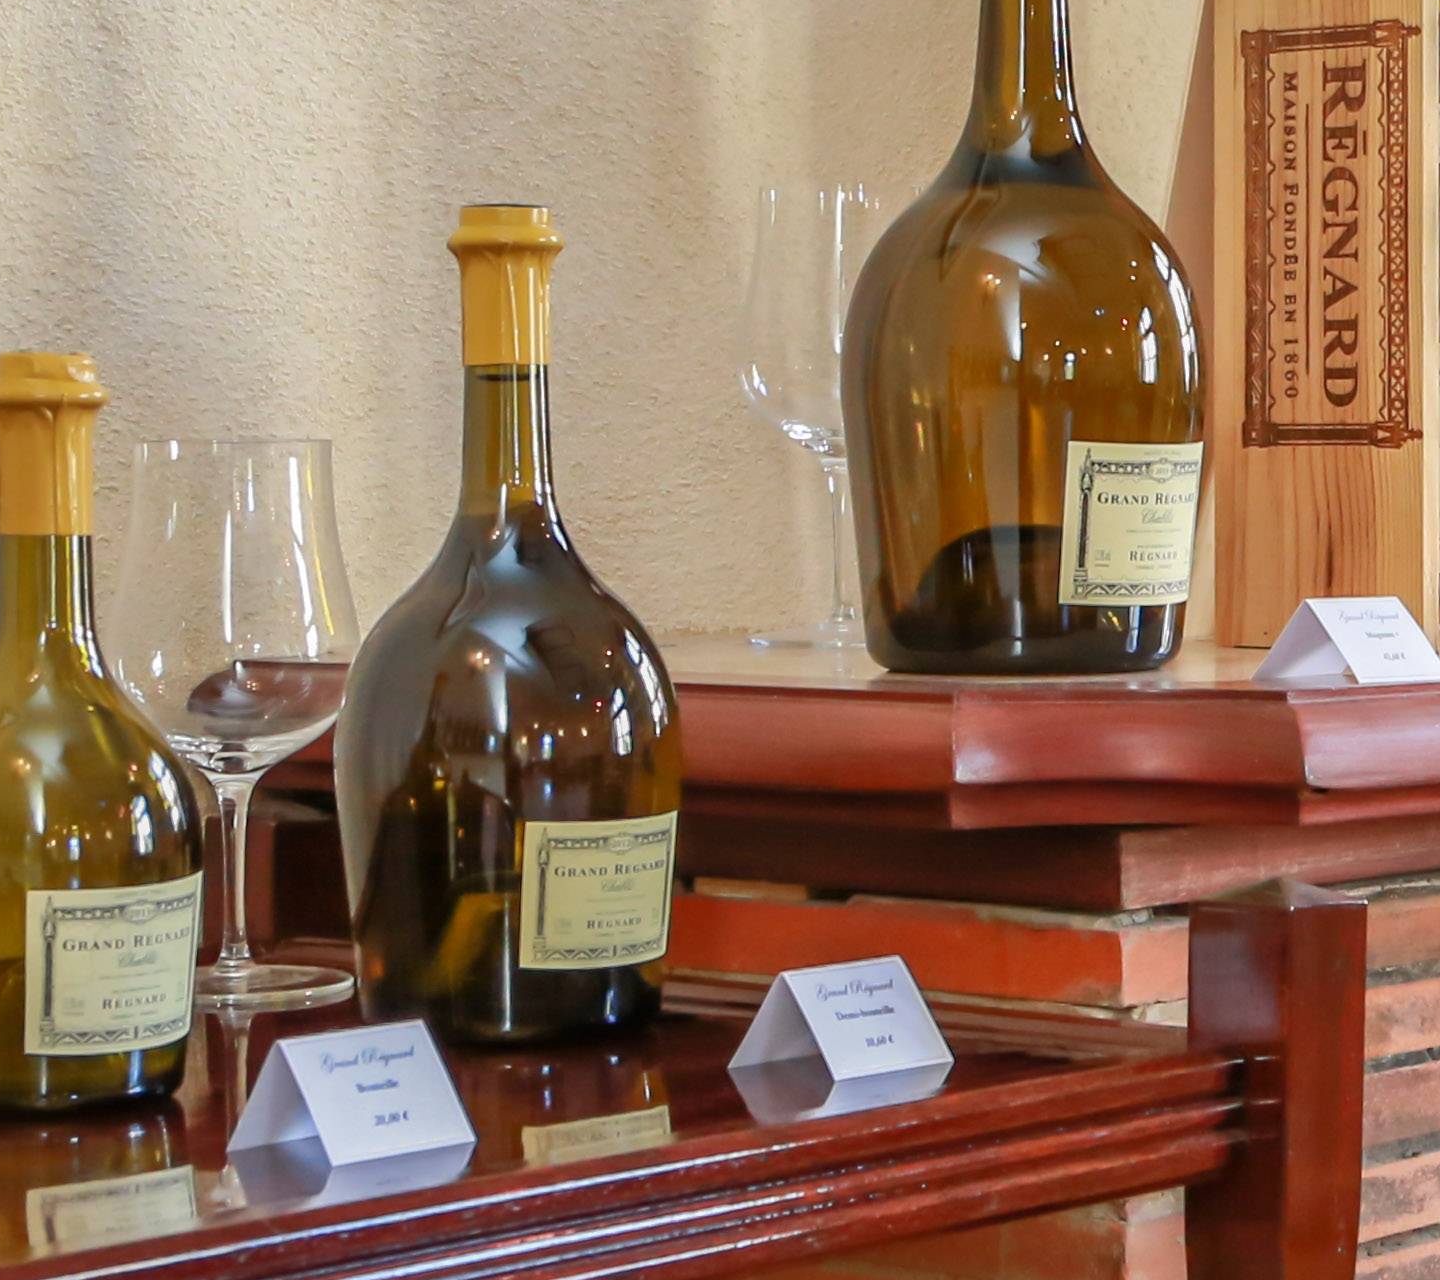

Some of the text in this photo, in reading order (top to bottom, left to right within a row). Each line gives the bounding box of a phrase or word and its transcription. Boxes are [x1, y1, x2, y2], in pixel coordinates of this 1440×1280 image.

[1283, 71, 1299, 171] MAISON
[1284, 294, 1298, 323] EN
[1284, 338, 1299, 399] 1860
[1097, 490, 1149, 506] GRAND
[554, 865, 608, 879] GRAND
[62, 937, 126, 953] GRAND
